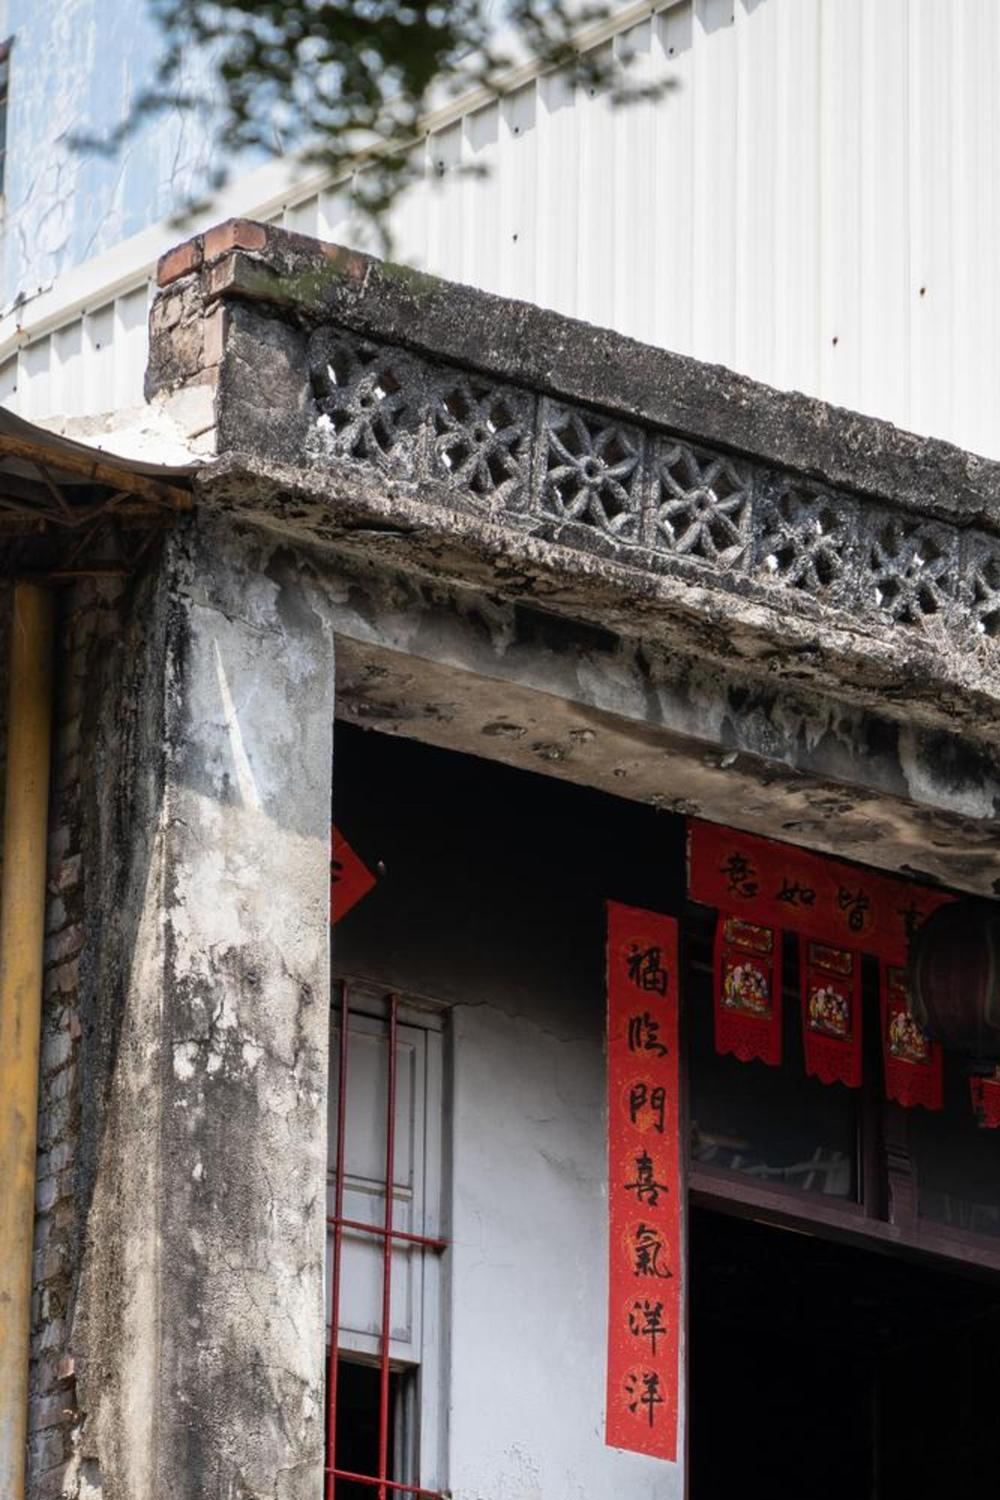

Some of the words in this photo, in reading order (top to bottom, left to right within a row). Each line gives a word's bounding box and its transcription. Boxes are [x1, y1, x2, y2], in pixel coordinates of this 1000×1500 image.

[624, 943, 673, 1430] 福臨門喜氣洋洋
